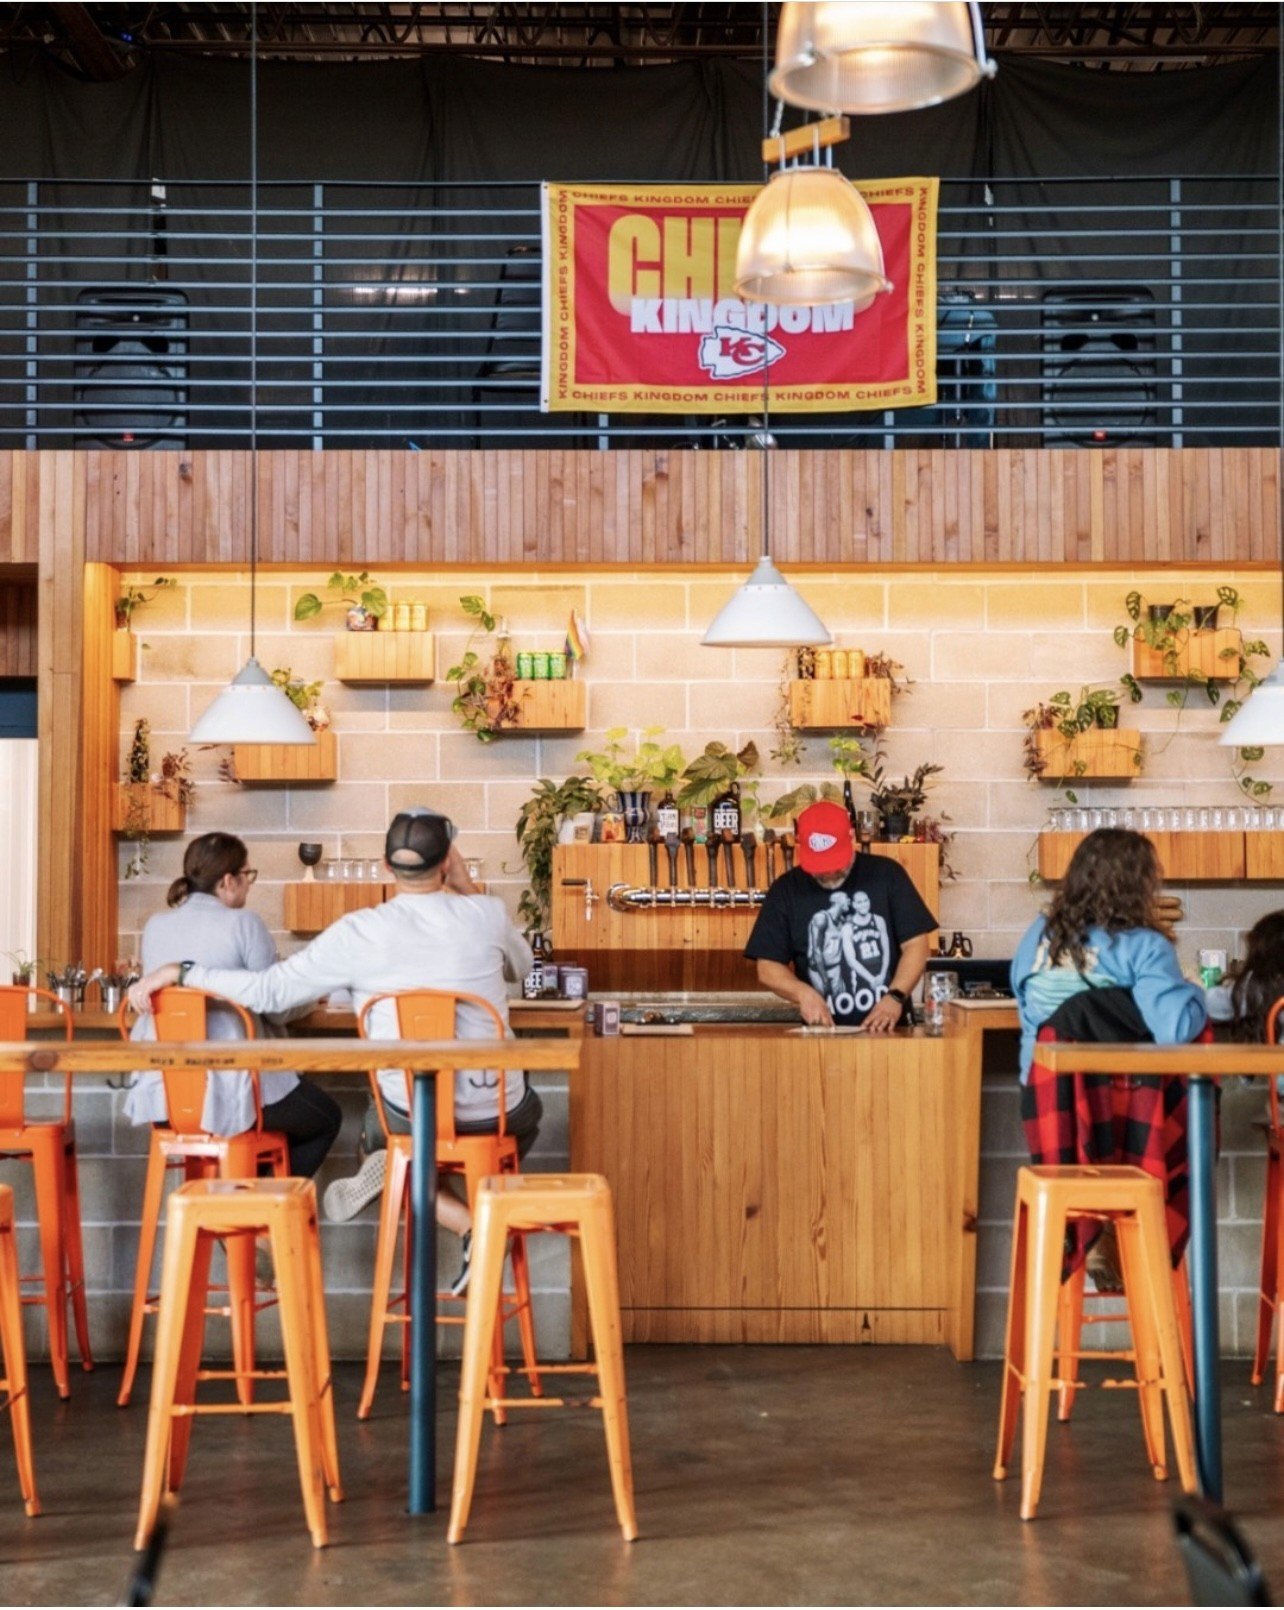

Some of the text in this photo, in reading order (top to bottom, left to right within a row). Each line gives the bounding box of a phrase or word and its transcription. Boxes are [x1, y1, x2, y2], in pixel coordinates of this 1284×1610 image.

[572, 190, 629, 201] CHIEFS
[634, 195, 709, 204] KINGDOM
[715, 195, 756, 204] CHIE
[558, 190, 569, 399] KINGDOM CHIEFS KINGDOM
[915, 186, 928, 394] KINGDOM CHIEFS KINGDOM
[630, 297, 855, 335] KINGDOM
[572, 386, 913, 402] CHIEFS KINGDOM CHIEFS KINGDOM CHIEFS
